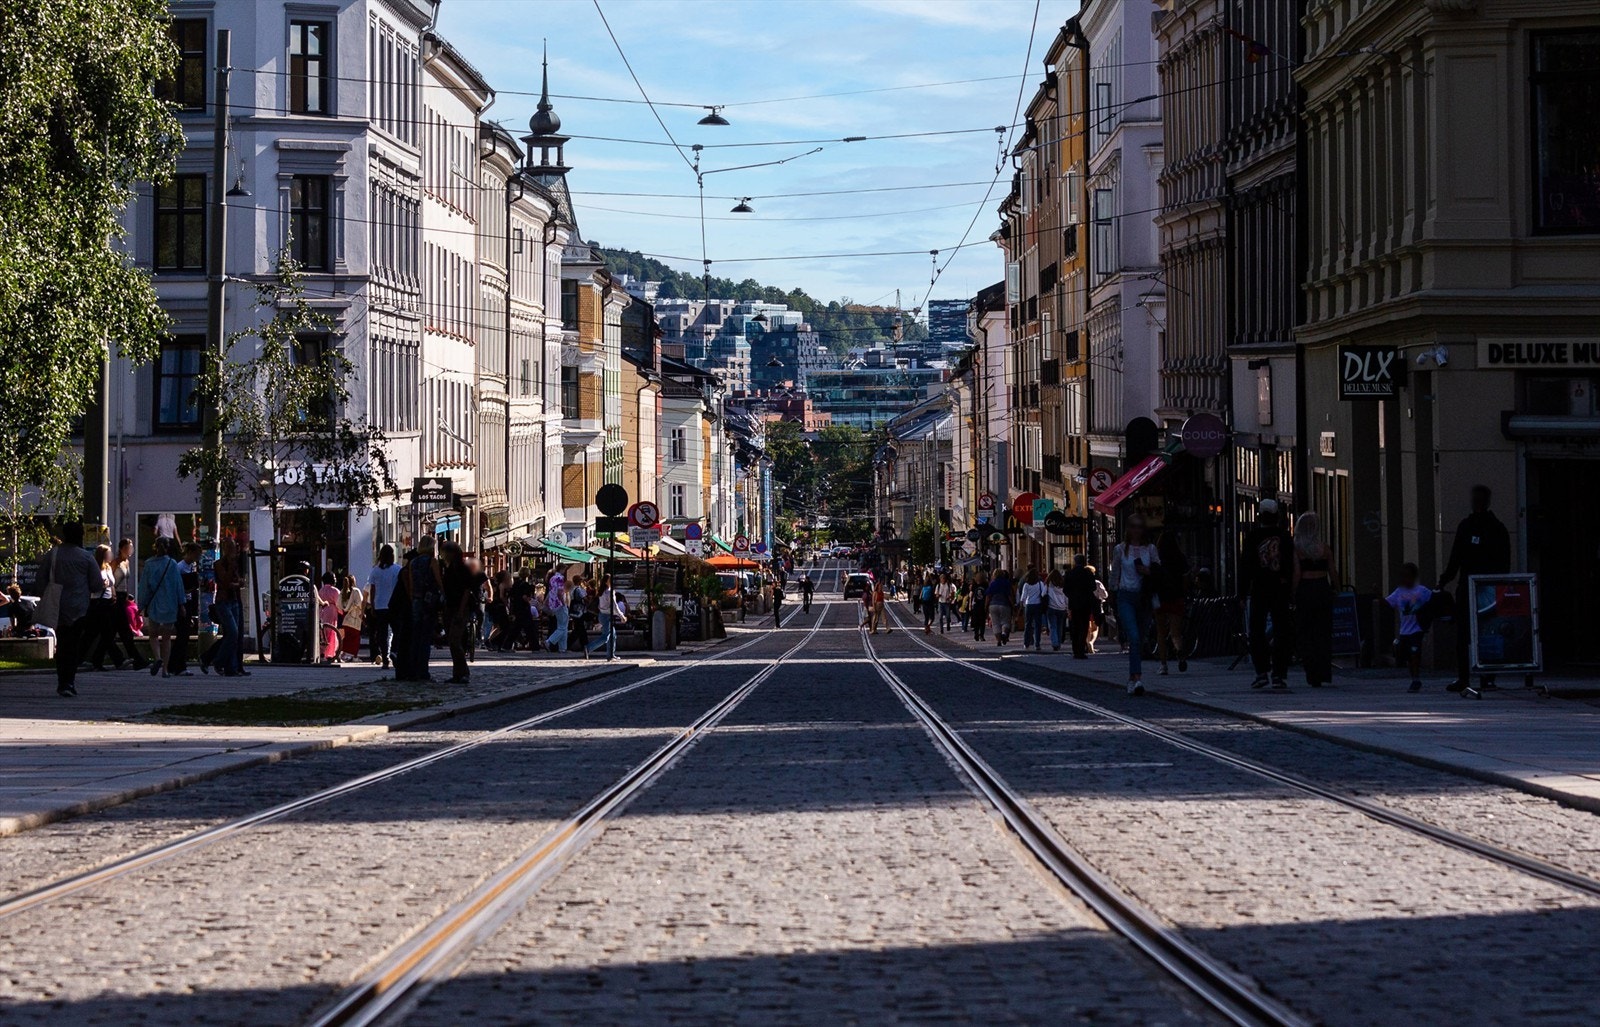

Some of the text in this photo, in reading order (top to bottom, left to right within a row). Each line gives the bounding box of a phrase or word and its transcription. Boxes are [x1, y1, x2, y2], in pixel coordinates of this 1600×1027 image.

[1489, 343, 1568, 363] DELUXE
[1344, 351, 1395, 382] DLX
[1344, 383, 1393, 392] DELUXE MUSIC
[1183, 431, 1225, 440] COUCH
